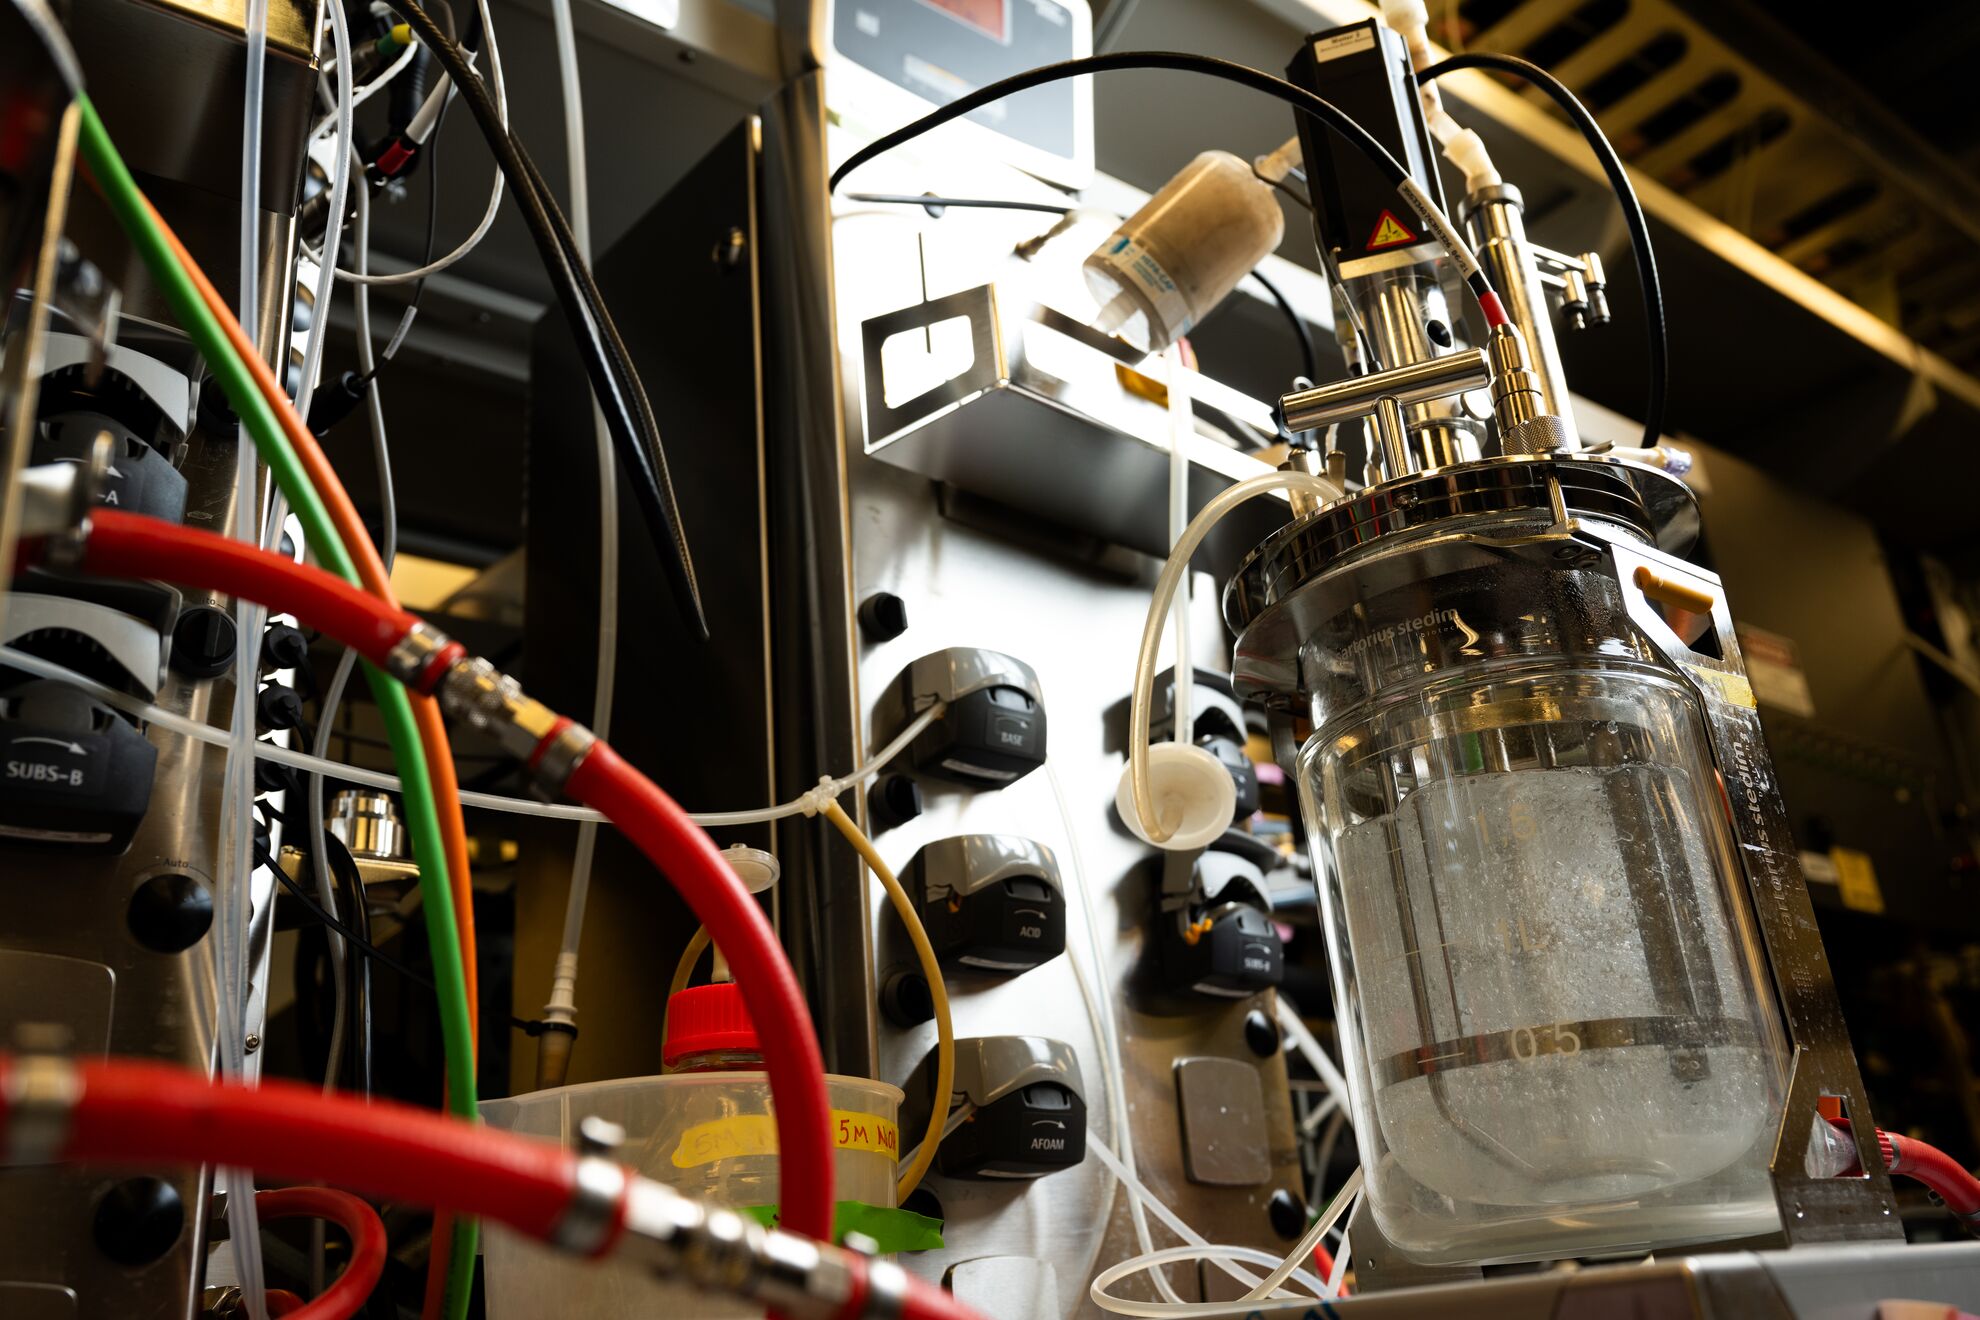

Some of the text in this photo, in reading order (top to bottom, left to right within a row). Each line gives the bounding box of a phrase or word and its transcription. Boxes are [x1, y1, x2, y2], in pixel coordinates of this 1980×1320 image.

[1398, 607, 1458, 635] stedim
[6, 760, 84, 786] SUBS-B
[1733, 741, 1765, 826] stedim
[163, 857, 189, 868] Auto
[1020, 926, 1042, 939] ACID
[1031, 1137, 1065, 1150] AFOAM
